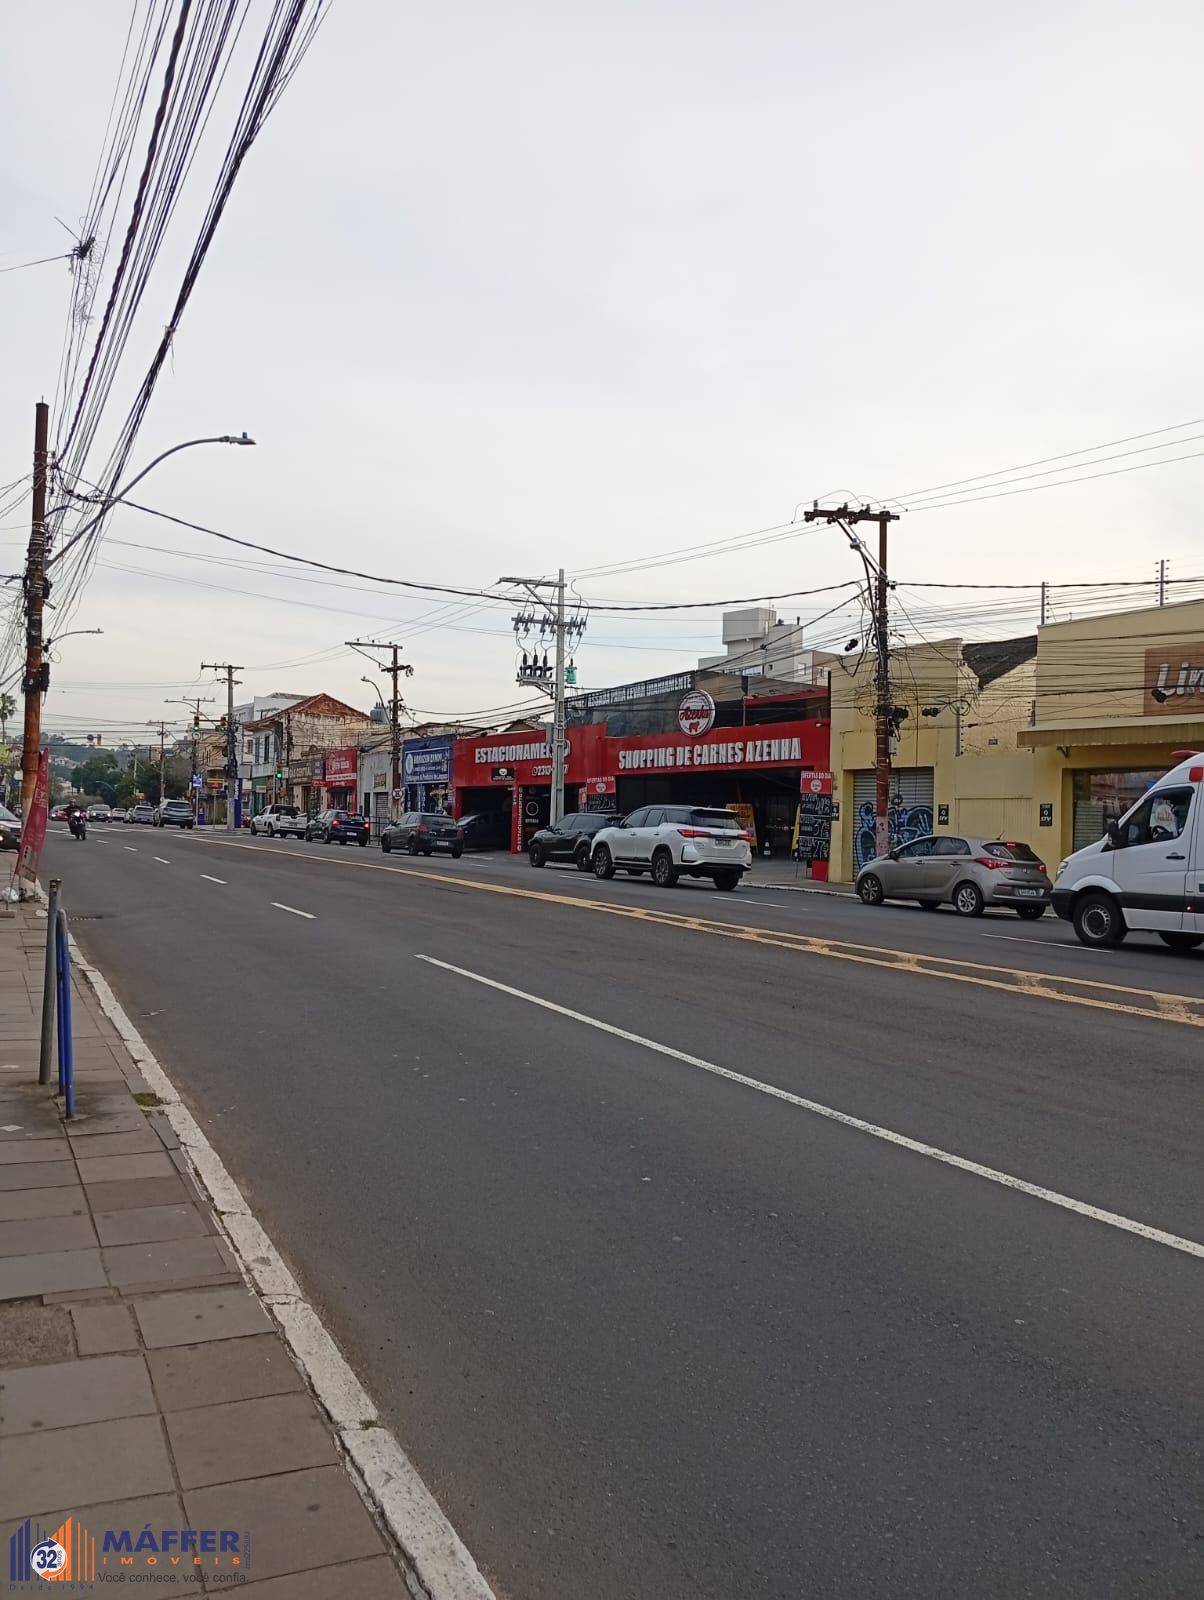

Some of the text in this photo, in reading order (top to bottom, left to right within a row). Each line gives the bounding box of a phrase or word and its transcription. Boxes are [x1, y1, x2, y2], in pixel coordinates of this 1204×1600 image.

[618, 738, 802, 769] SHOPPING DE CARNES AZENHA
